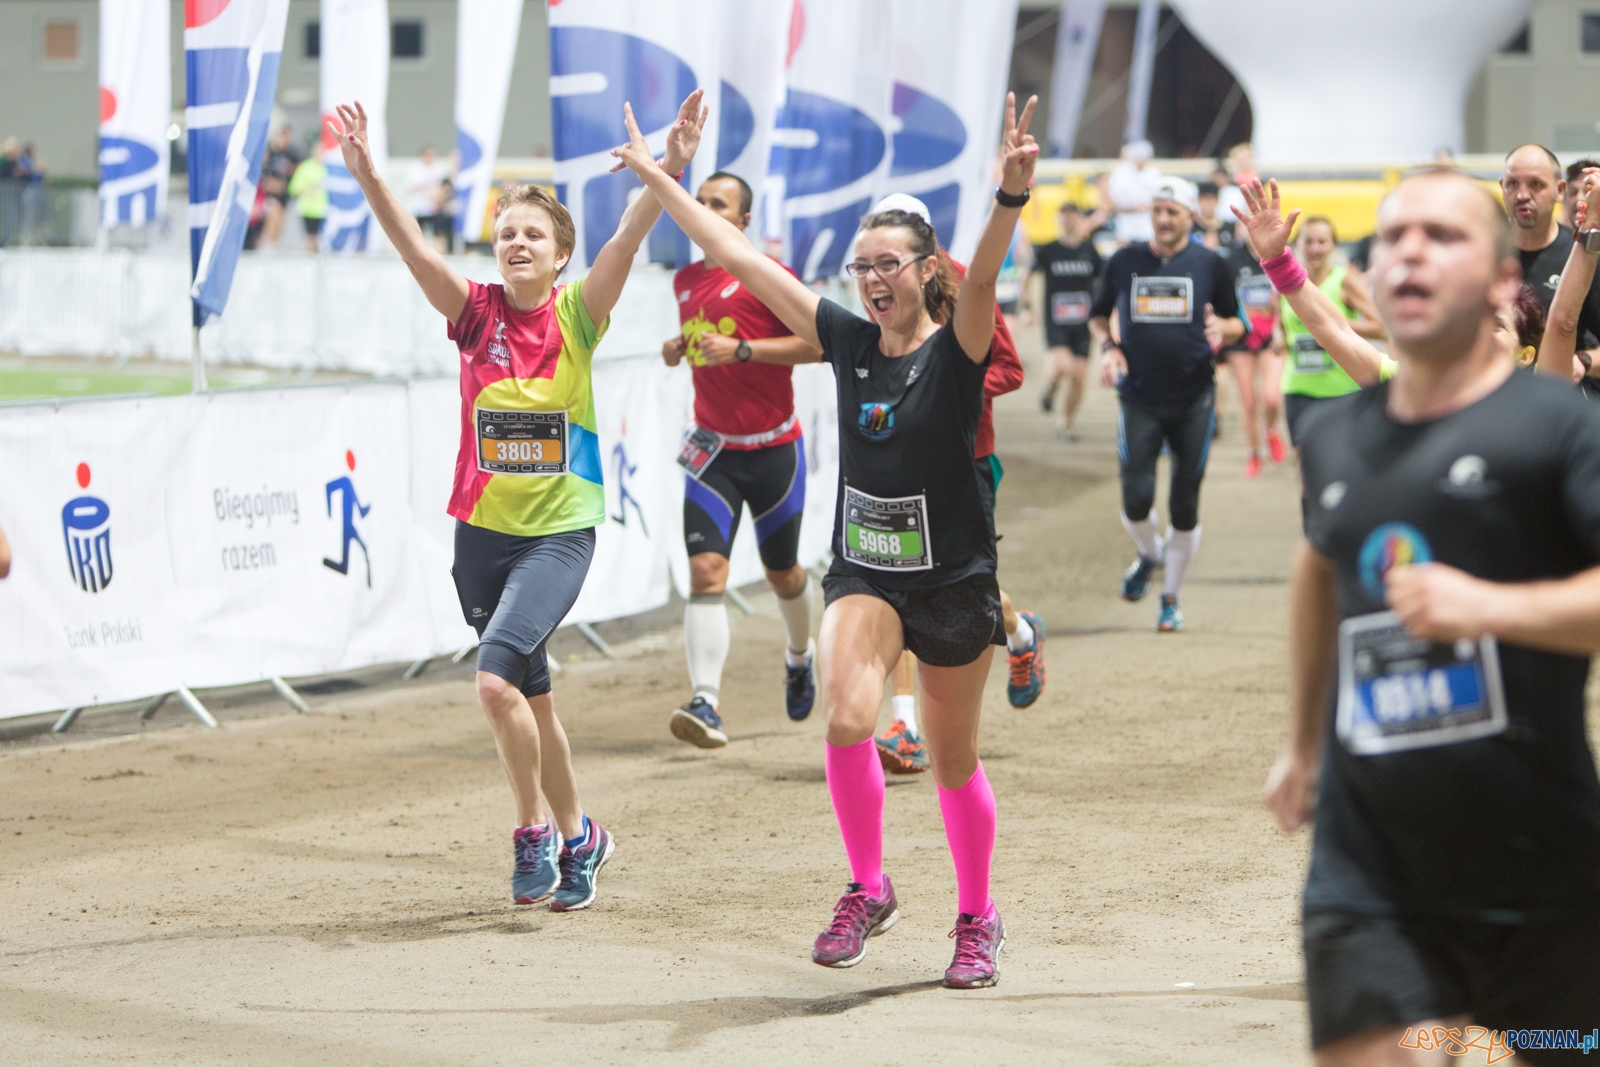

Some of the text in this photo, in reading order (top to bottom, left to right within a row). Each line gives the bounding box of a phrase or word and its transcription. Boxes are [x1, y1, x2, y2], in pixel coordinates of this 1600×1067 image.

[496, 441, 544, 461] 3803
[213, 484, 300, 529] Biegajmy
[859, 528, 902, 555] 5968
[221, 542, 277, 571] razem
[101, 617, 143, 645] Polski
